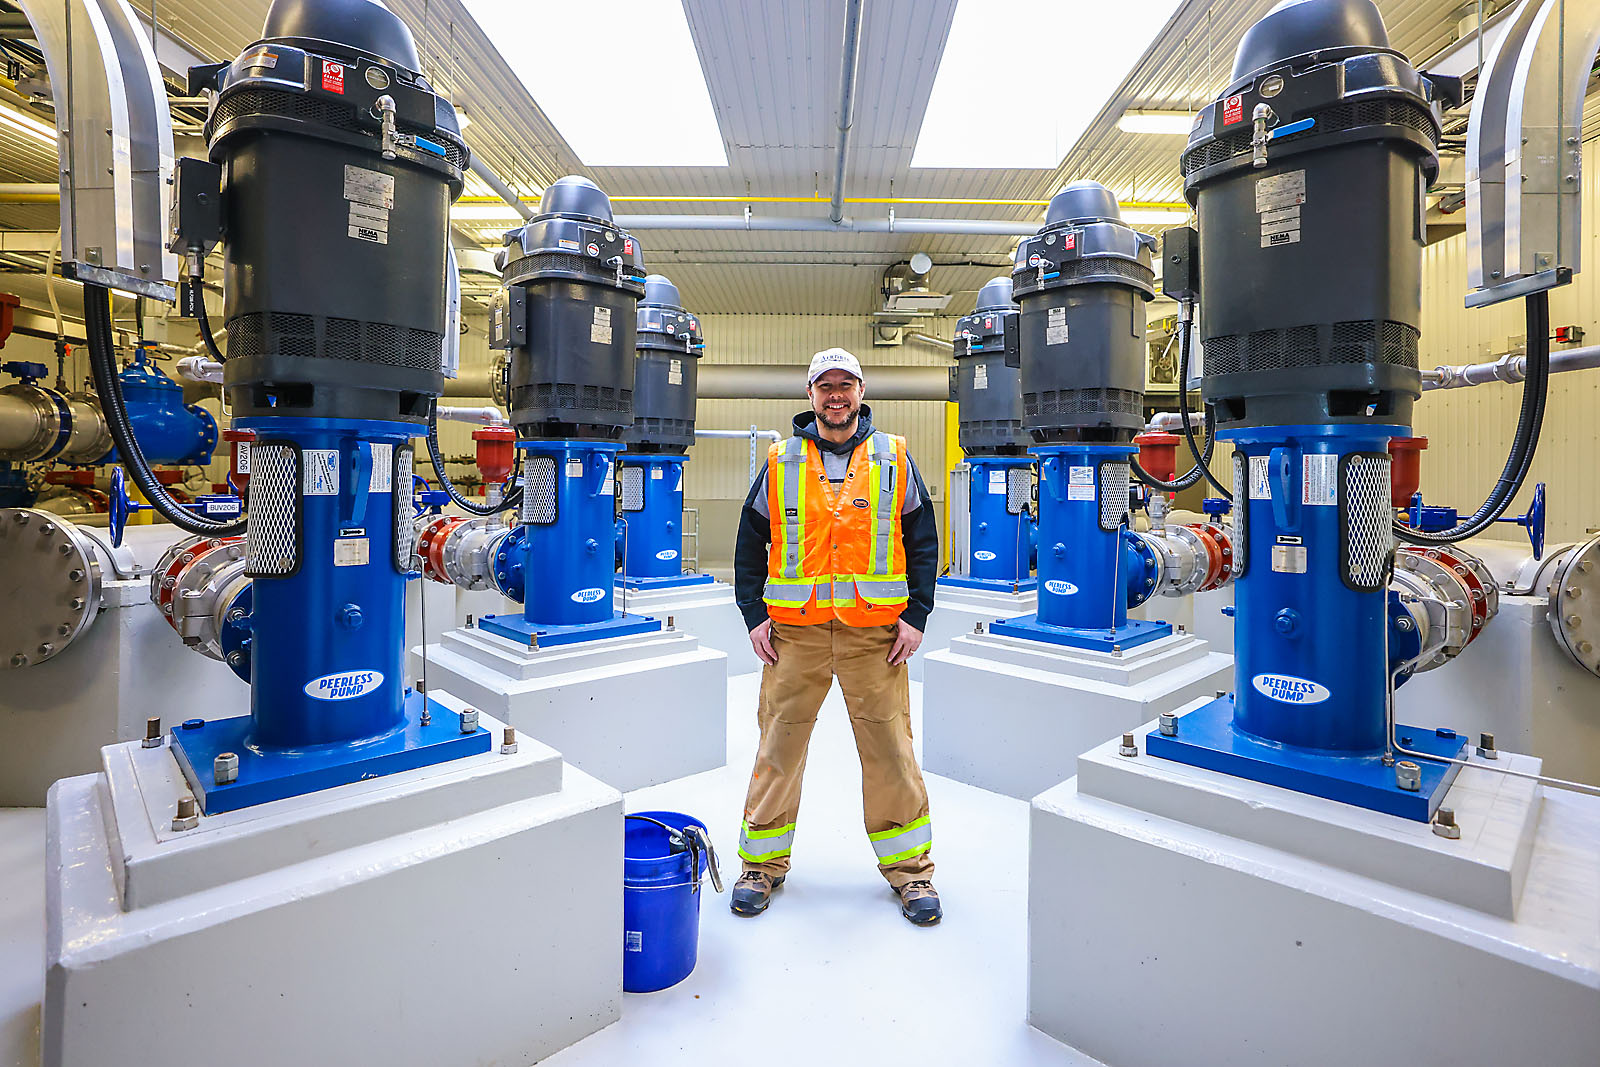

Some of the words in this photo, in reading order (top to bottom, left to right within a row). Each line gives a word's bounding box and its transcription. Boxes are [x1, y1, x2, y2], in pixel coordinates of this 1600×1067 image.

[1270, 232, 1289, 241] NEMA
[240, 444, 248, 470] AV206
[319, 672, 373, 689] PEERLESS
[1262, 676, 1315, 694] PEERLESS
[329, 684, 364, 698] PUMP
[1271, 687, 1304, 702] PUMP
